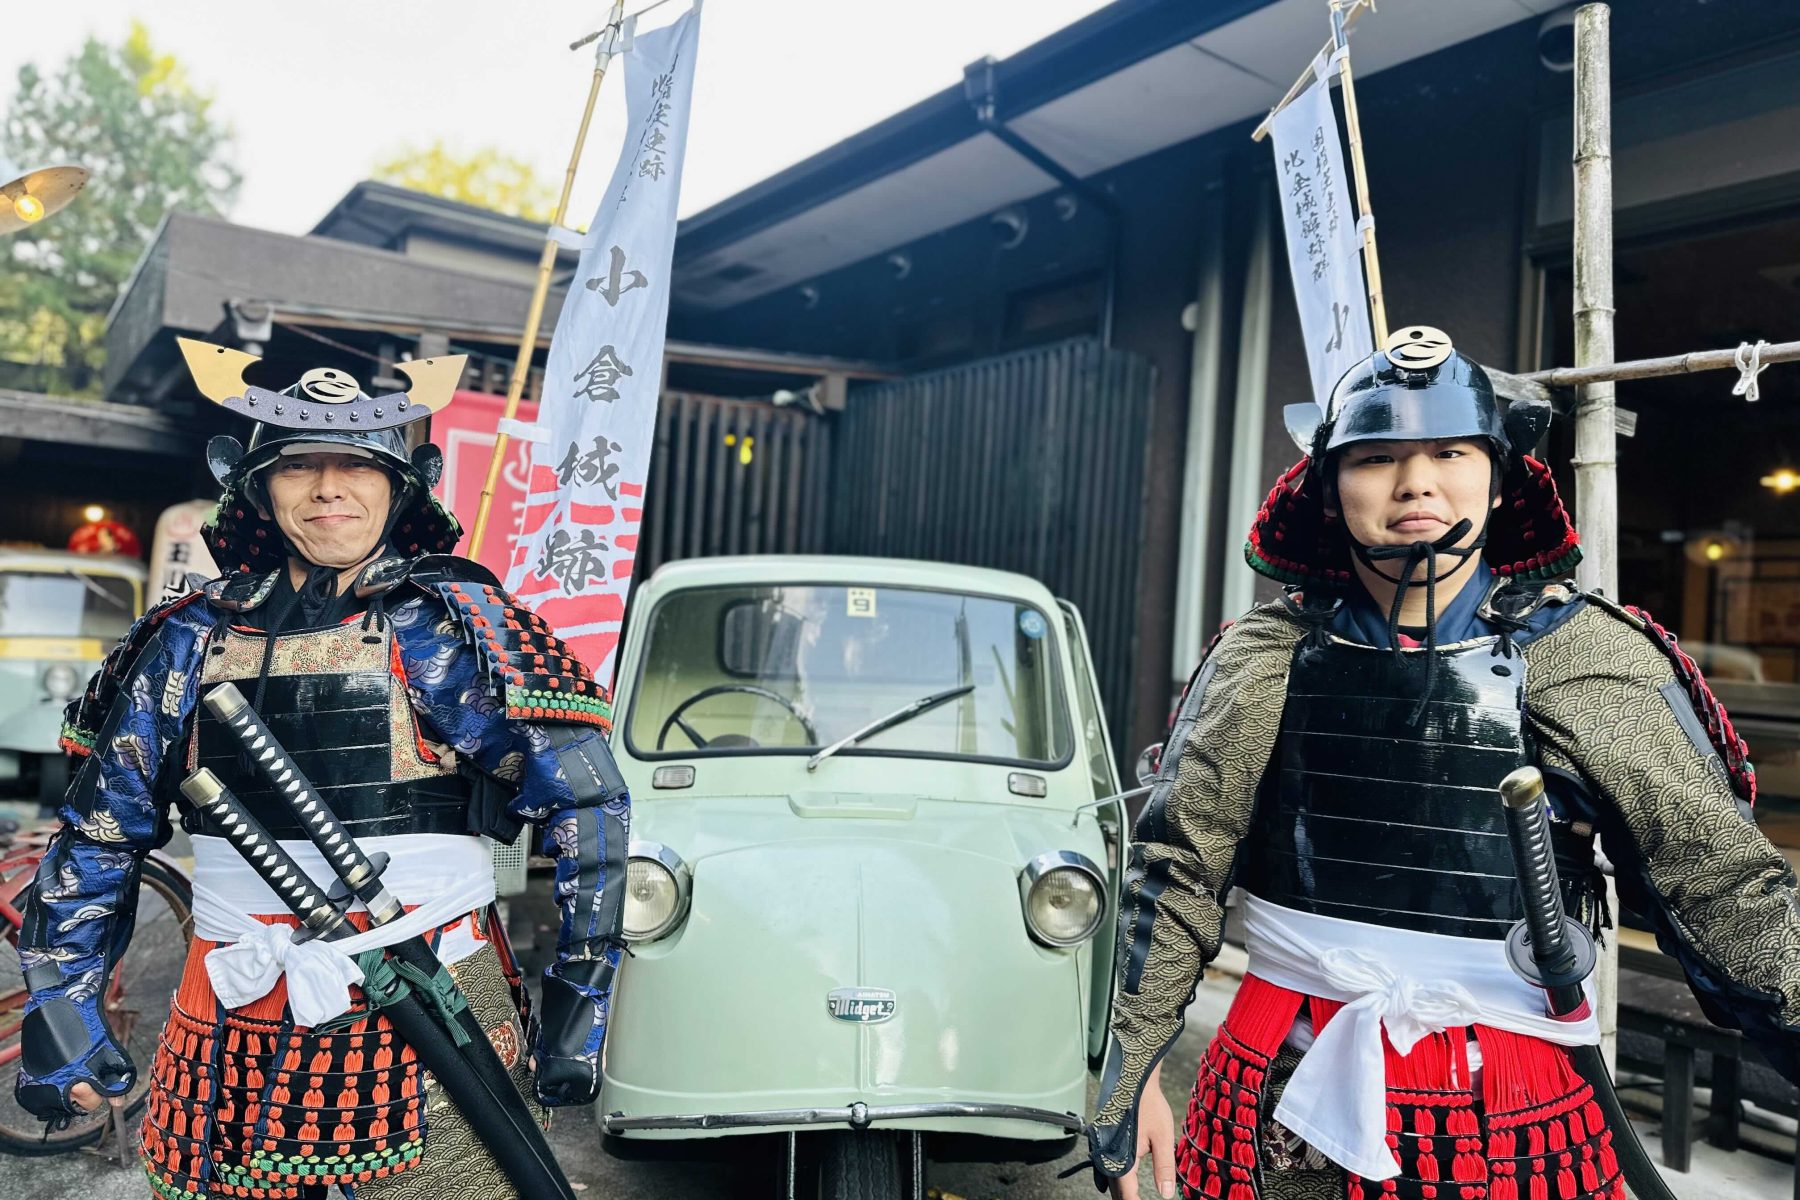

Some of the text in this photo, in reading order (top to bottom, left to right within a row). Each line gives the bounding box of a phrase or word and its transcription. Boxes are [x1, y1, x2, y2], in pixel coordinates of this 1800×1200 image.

[537, 244, 649, 596] 小倉城跡
[833, 999, 891, 1021] Midget
